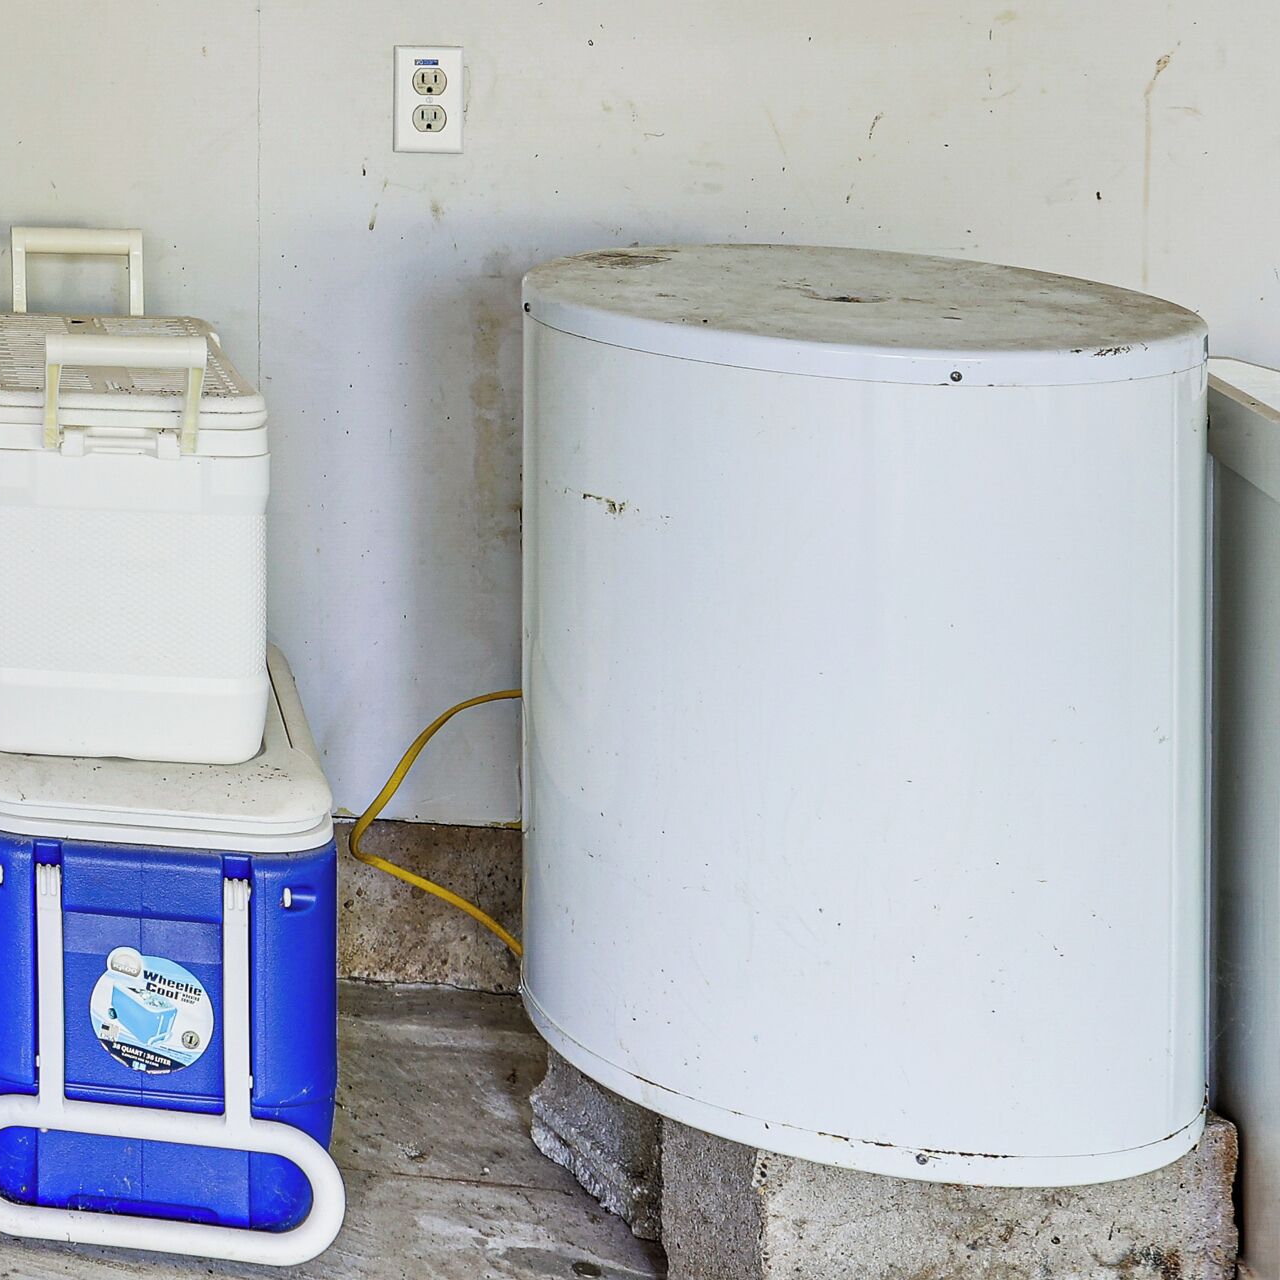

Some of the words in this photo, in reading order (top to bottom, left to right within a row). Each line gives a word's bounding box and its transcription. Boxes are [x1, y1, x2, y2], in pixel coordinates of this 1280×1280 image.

[143, 970, 202, 997] Wheelie
[146, 982, 179, 1001] Cool
[120, 1045, 144, 1057] QUART
[154, 1055, 172, 1066] LITER
